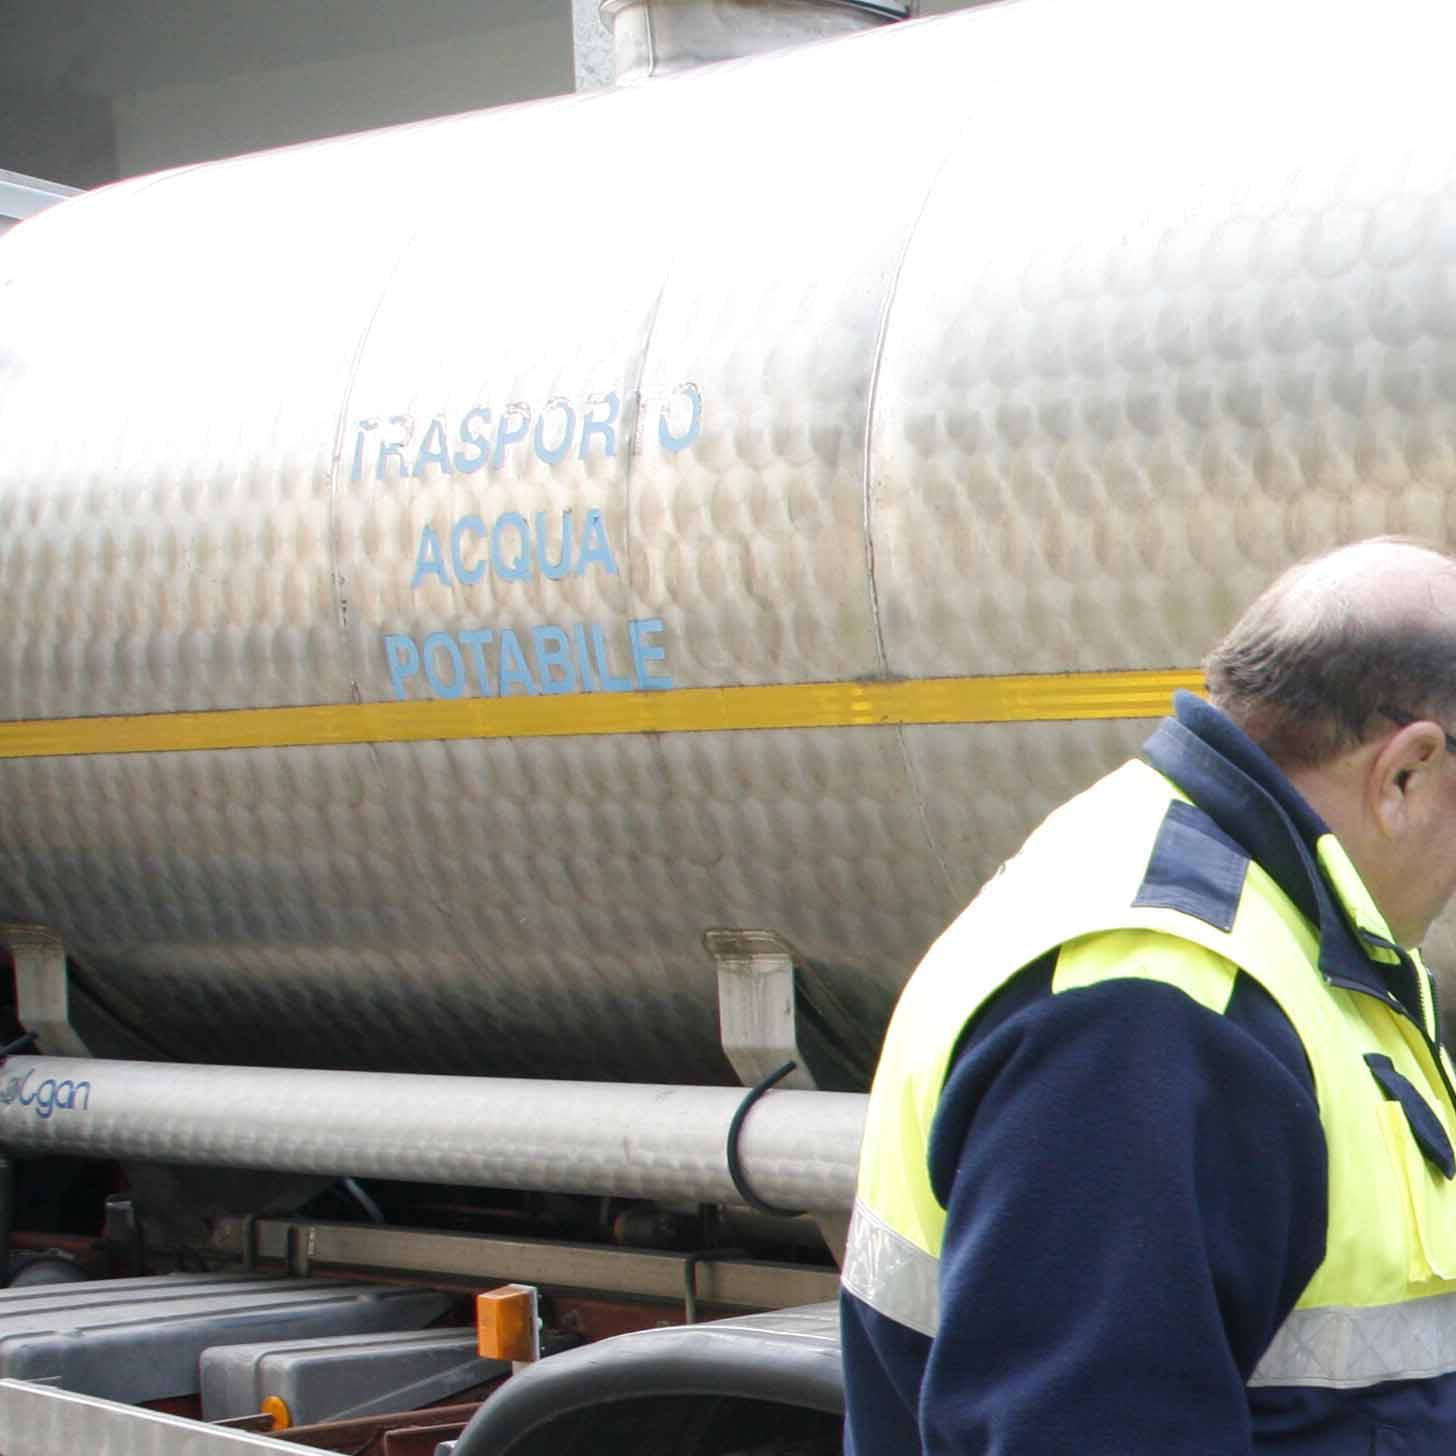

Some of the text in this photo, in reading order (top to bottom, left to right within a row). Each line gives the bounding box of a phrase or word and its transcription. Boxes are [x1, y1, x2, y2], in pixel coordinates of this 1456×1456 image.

[351, 382, 702, 480] TRASPORO
[411, 508, 619, 588] ACQUA
[384, 619, 673, 700] POTABILE
[0, 1067, 90, 1119] olgan
